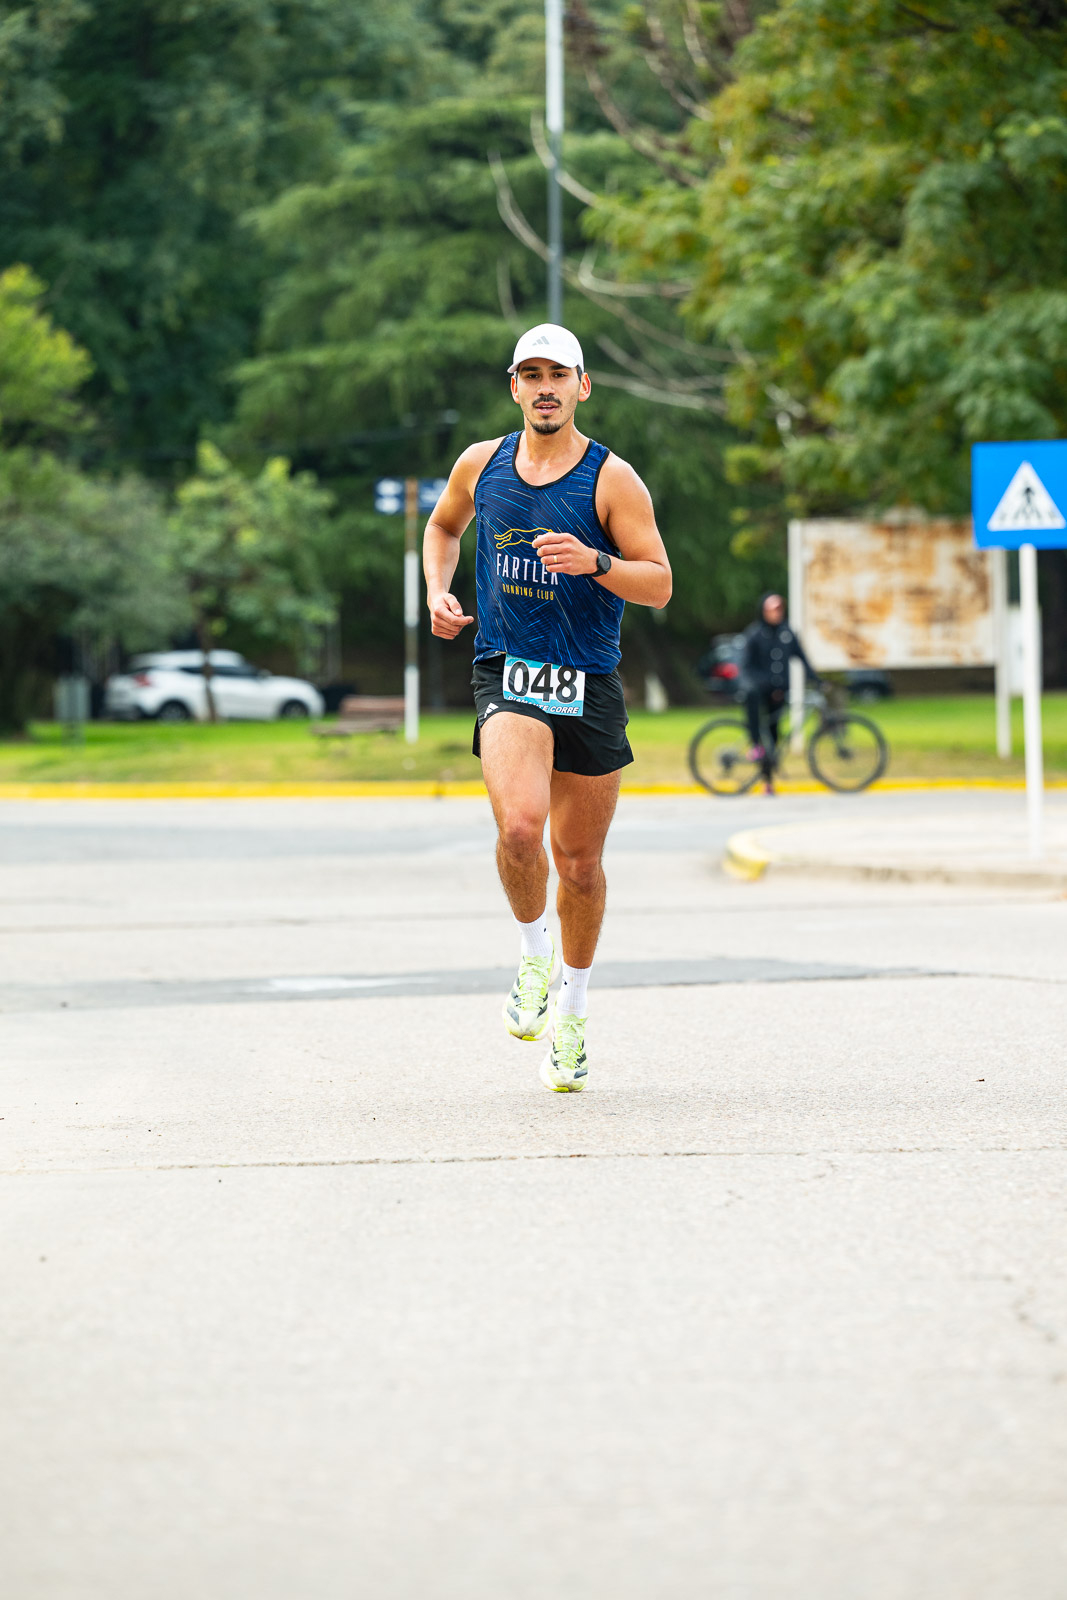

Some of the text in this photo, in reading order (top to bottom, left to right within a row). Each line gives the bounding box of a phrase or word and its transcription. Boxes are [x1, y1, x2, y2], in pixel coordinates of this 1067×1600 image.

[502, 583, 554, 601] RUNNING CLUB
[508, 661, 578, 704] 048
[550, 705, 580, 714] CORRE
